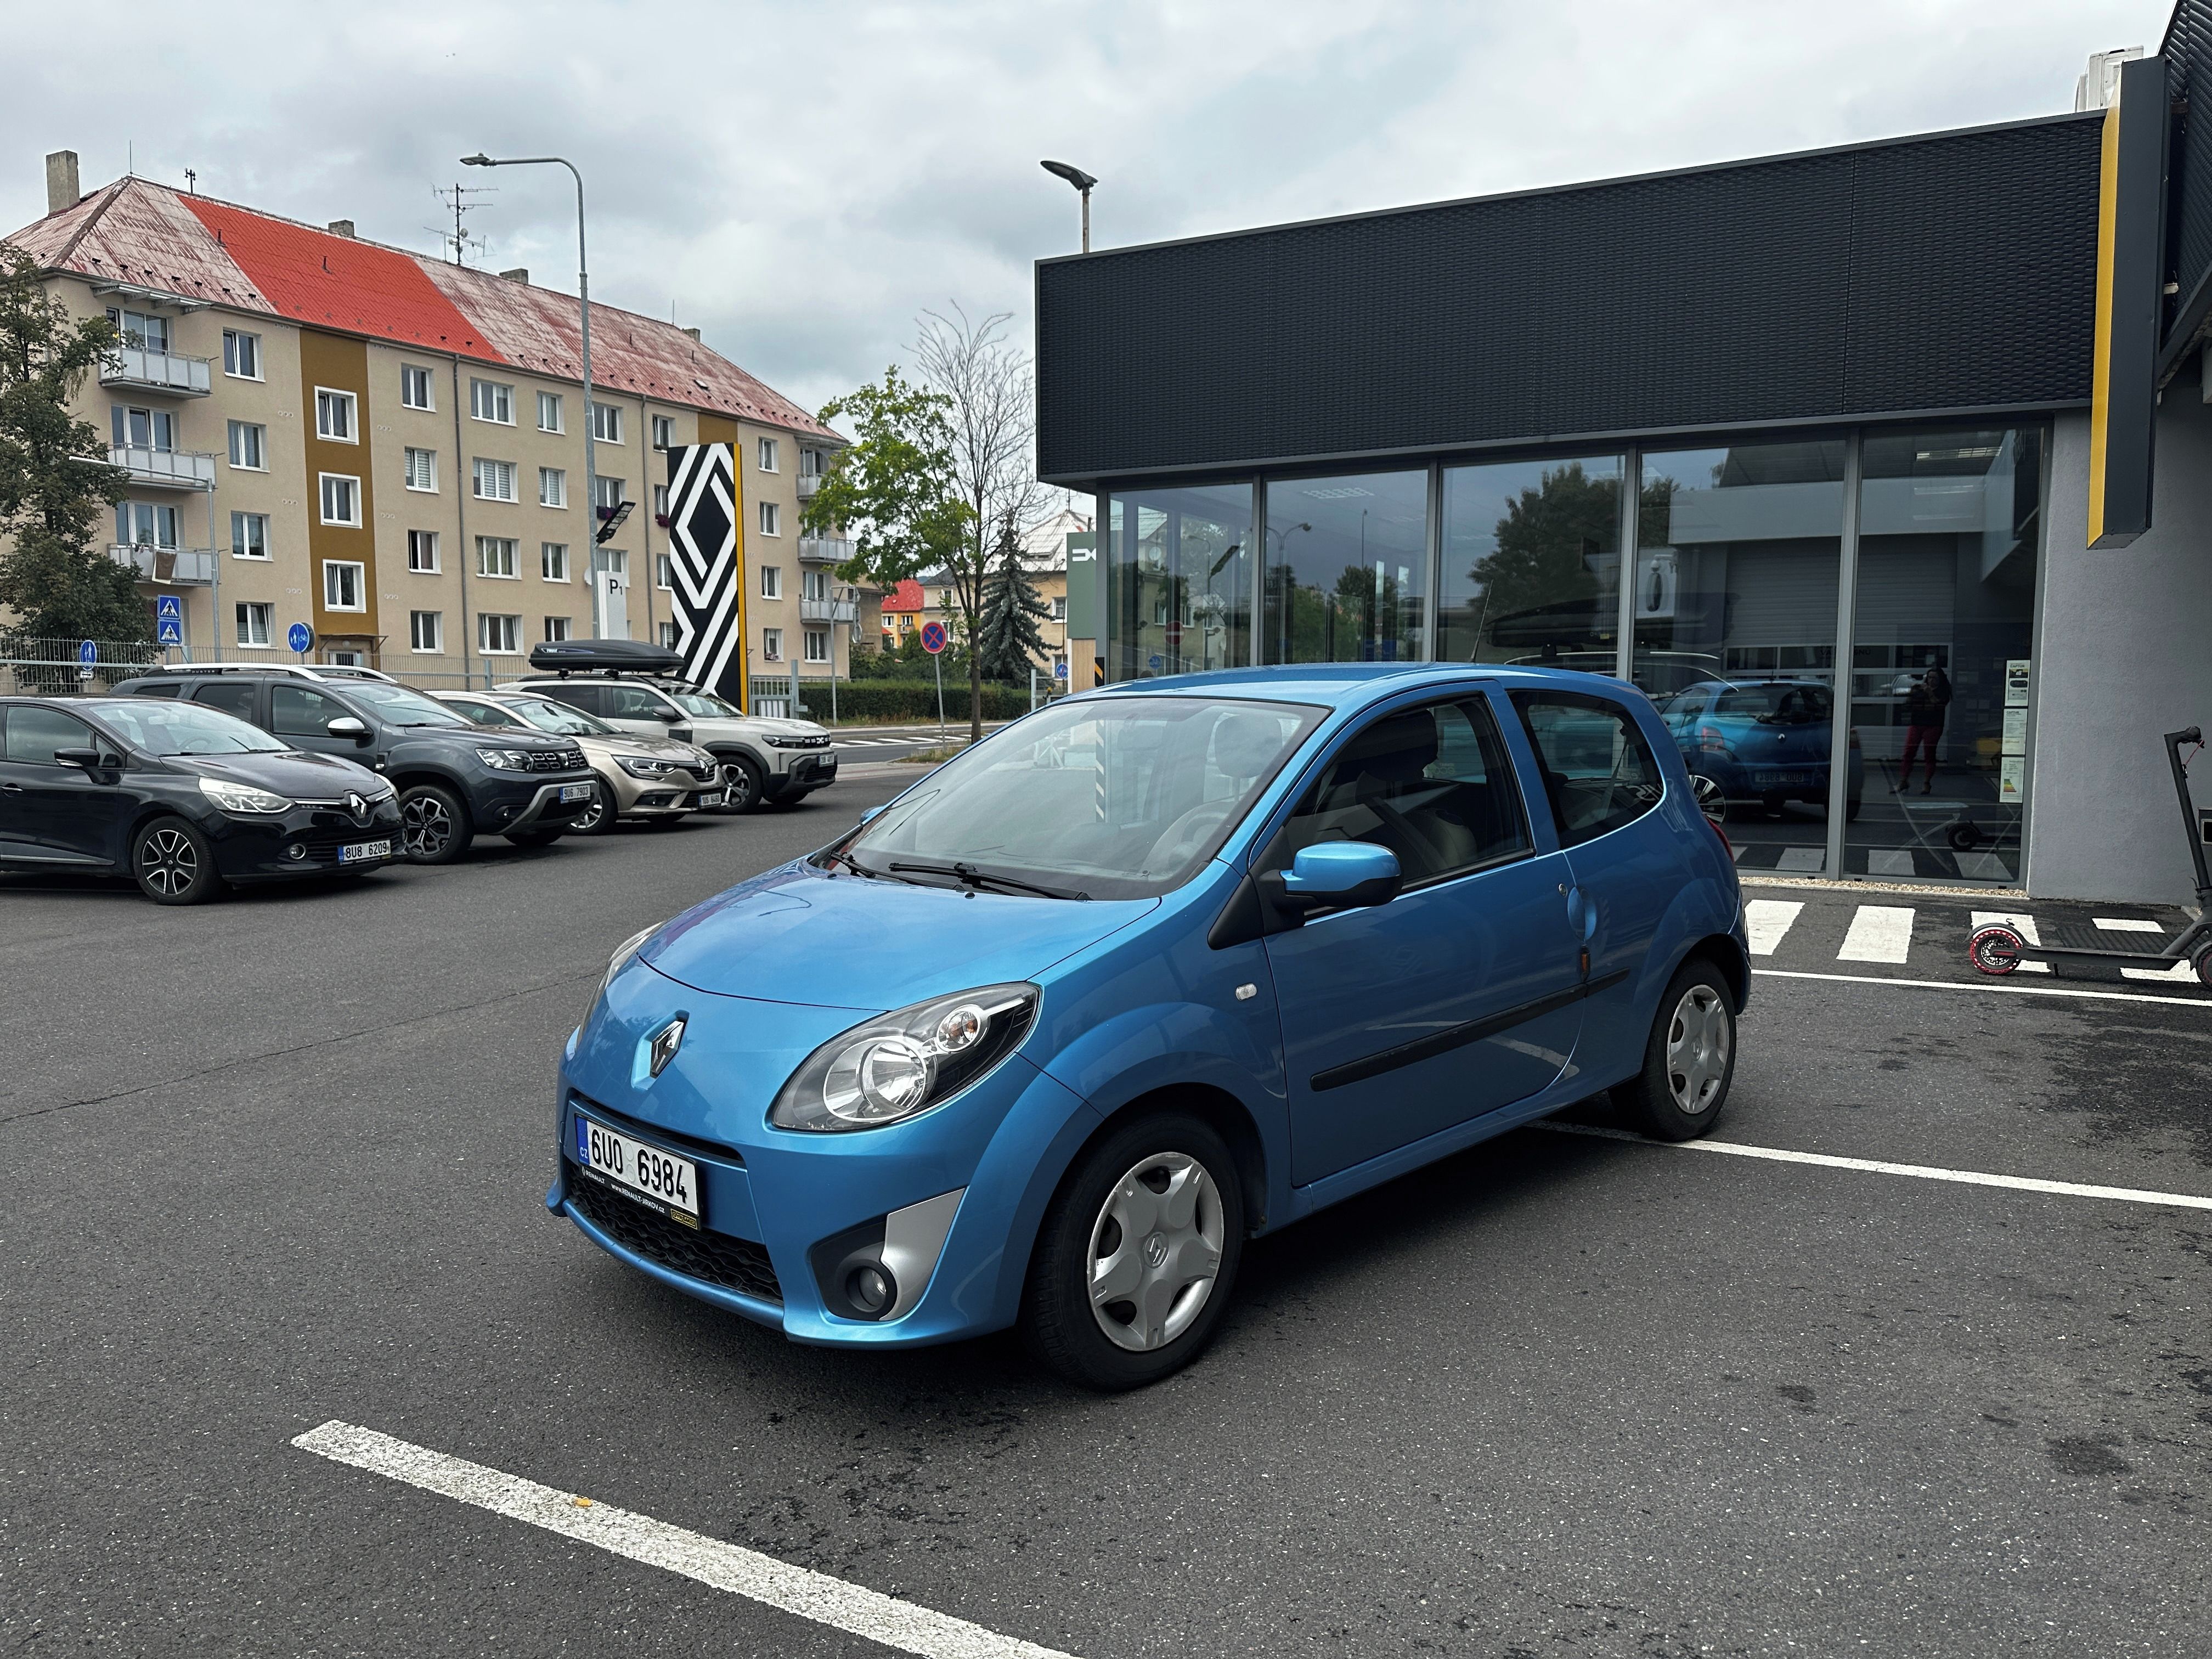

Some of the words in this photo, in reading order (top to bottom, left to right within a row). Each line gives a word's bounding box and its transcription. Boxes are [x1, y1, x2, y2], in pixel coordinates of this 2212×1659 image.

[346, 845, 362, 859] 8U8
[368, 842, 387, 855] 6209
[580, 1146, 588, 1159] CZ
[591, 1128, 623, 1174] 6U0
[637, 1148, 687, 1204] 6984
[585, 1170, 605, 1184] RENAULT
